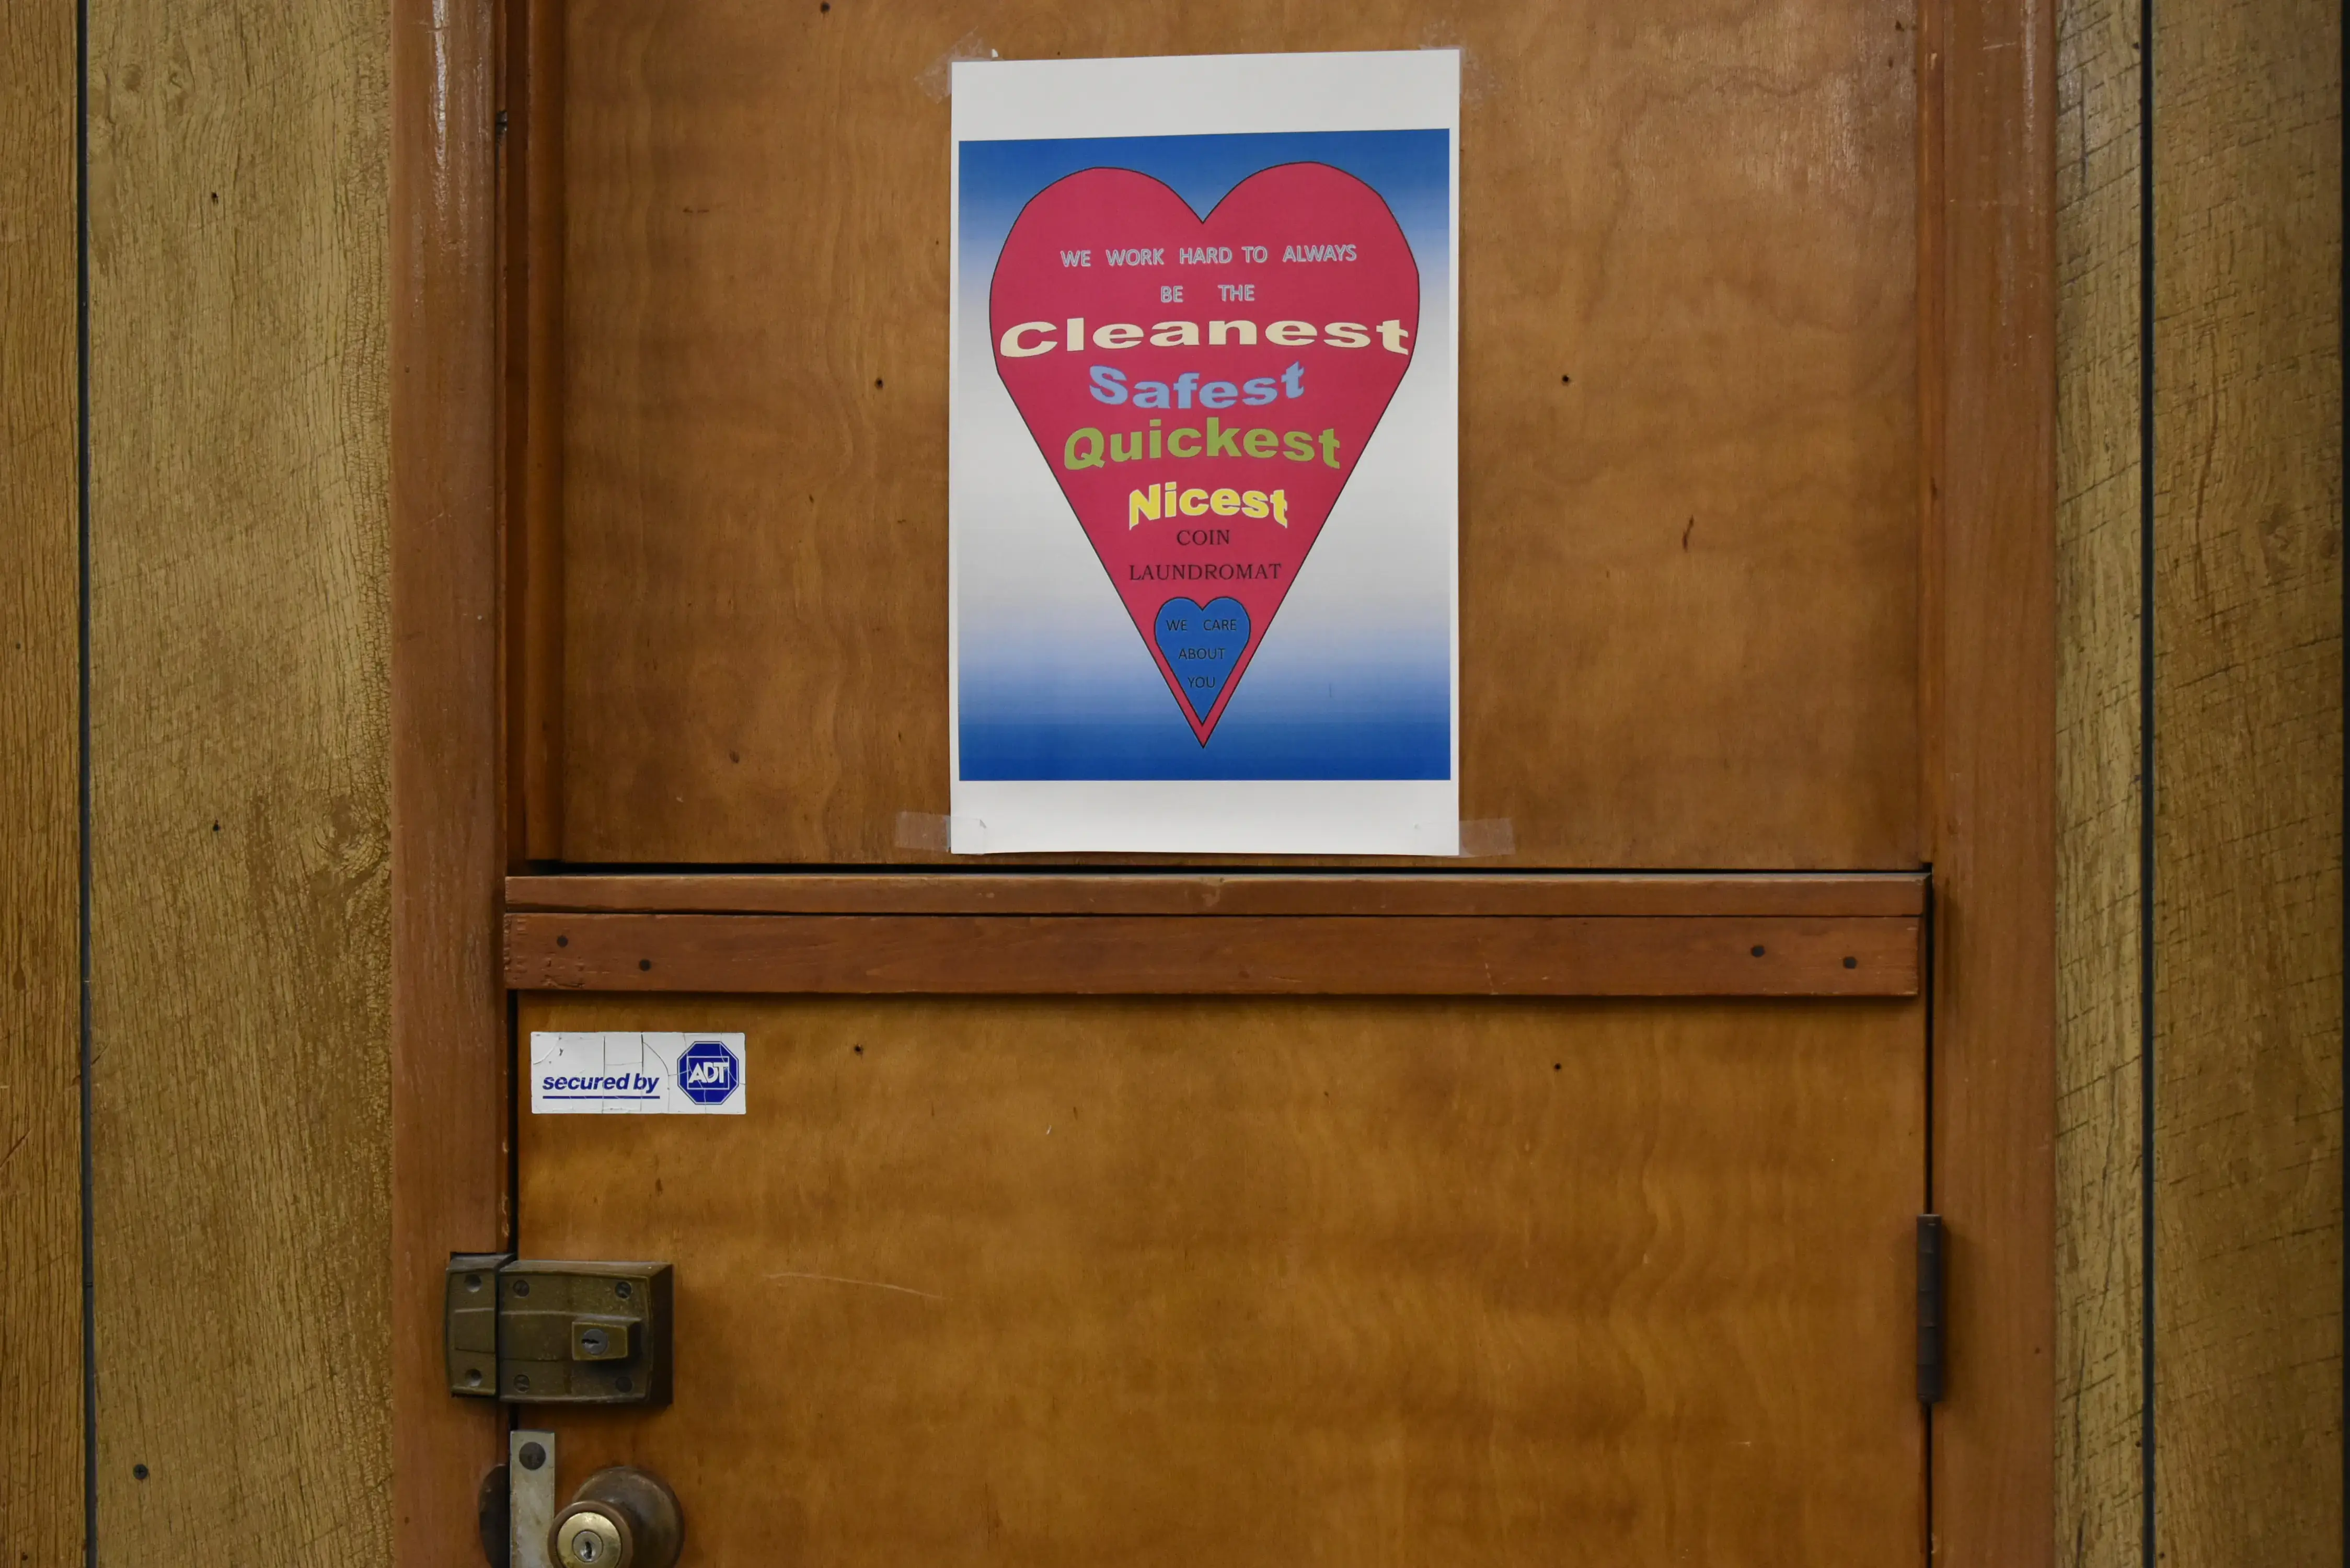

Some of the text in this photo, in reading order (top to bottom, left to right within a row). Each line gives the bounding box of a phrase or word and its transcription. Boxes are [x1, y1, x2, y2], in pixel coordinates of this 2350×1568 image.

[1061, 244, 1357, 268] WE WORK HARD TO ALWAYS
[1160, 284, 1254, 303] BE THE
[1000, 317, 1409, 358] Cleanest
[1089, 361, 1305, 409] Safest
[1064, 417, 1340, 470] Quickest
[1129, 481, 1288, 530] Nicest
[1177, 529, 1230, 546] COIN
[1129, 563, 1282, 581] LAUNDROMAT
[1166, 619, 1237, 631] WE CARE
[1178, 647, 1225, 660] ABOUT
[1187, 676, 1216, 688] YOU
[542, 1073, 660, 1093] secured by
[688, 1062, 729, 1084] ADT
